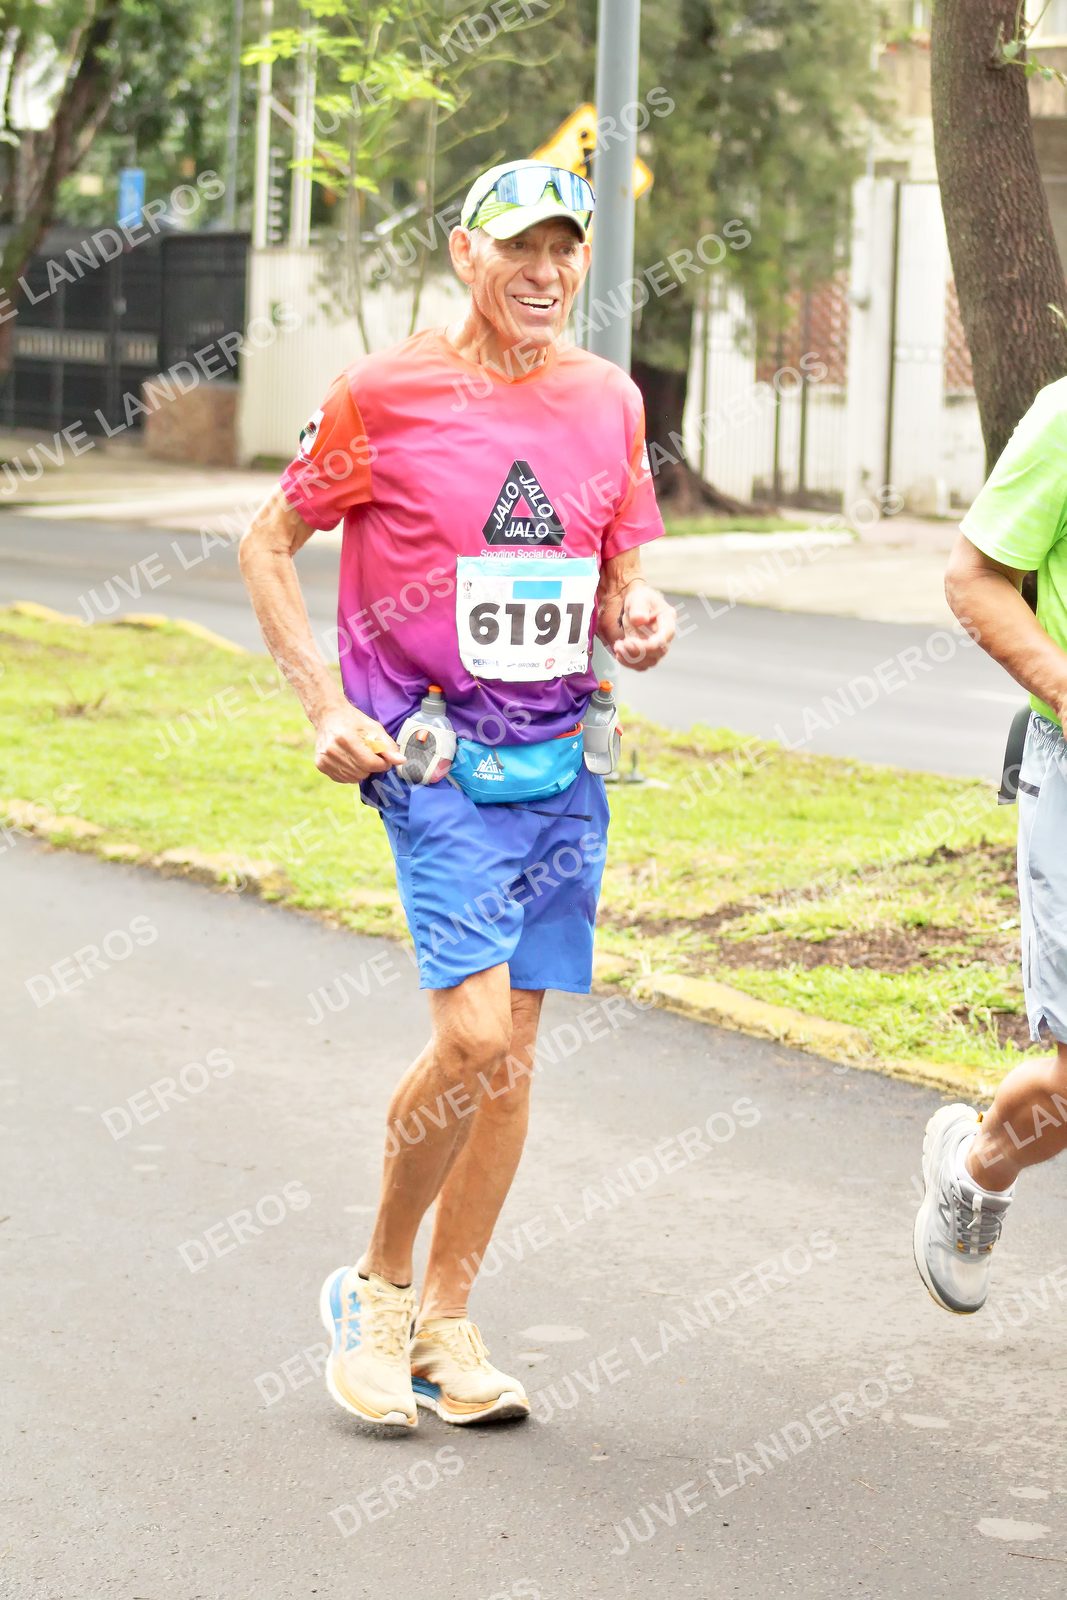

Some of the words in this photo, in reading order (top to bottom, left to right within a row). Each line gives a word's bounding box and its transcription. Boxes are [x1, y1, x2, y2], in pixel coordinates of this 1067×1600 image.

[495, 481, 519, 530] JALO
[518, 474, 554, 519] JALO
[505, 521, 549, 539] JALO
[516, 549, 544, 559] Social
[545, 549, 567, 559] Club
[469, 602, 585, 646] 6191
